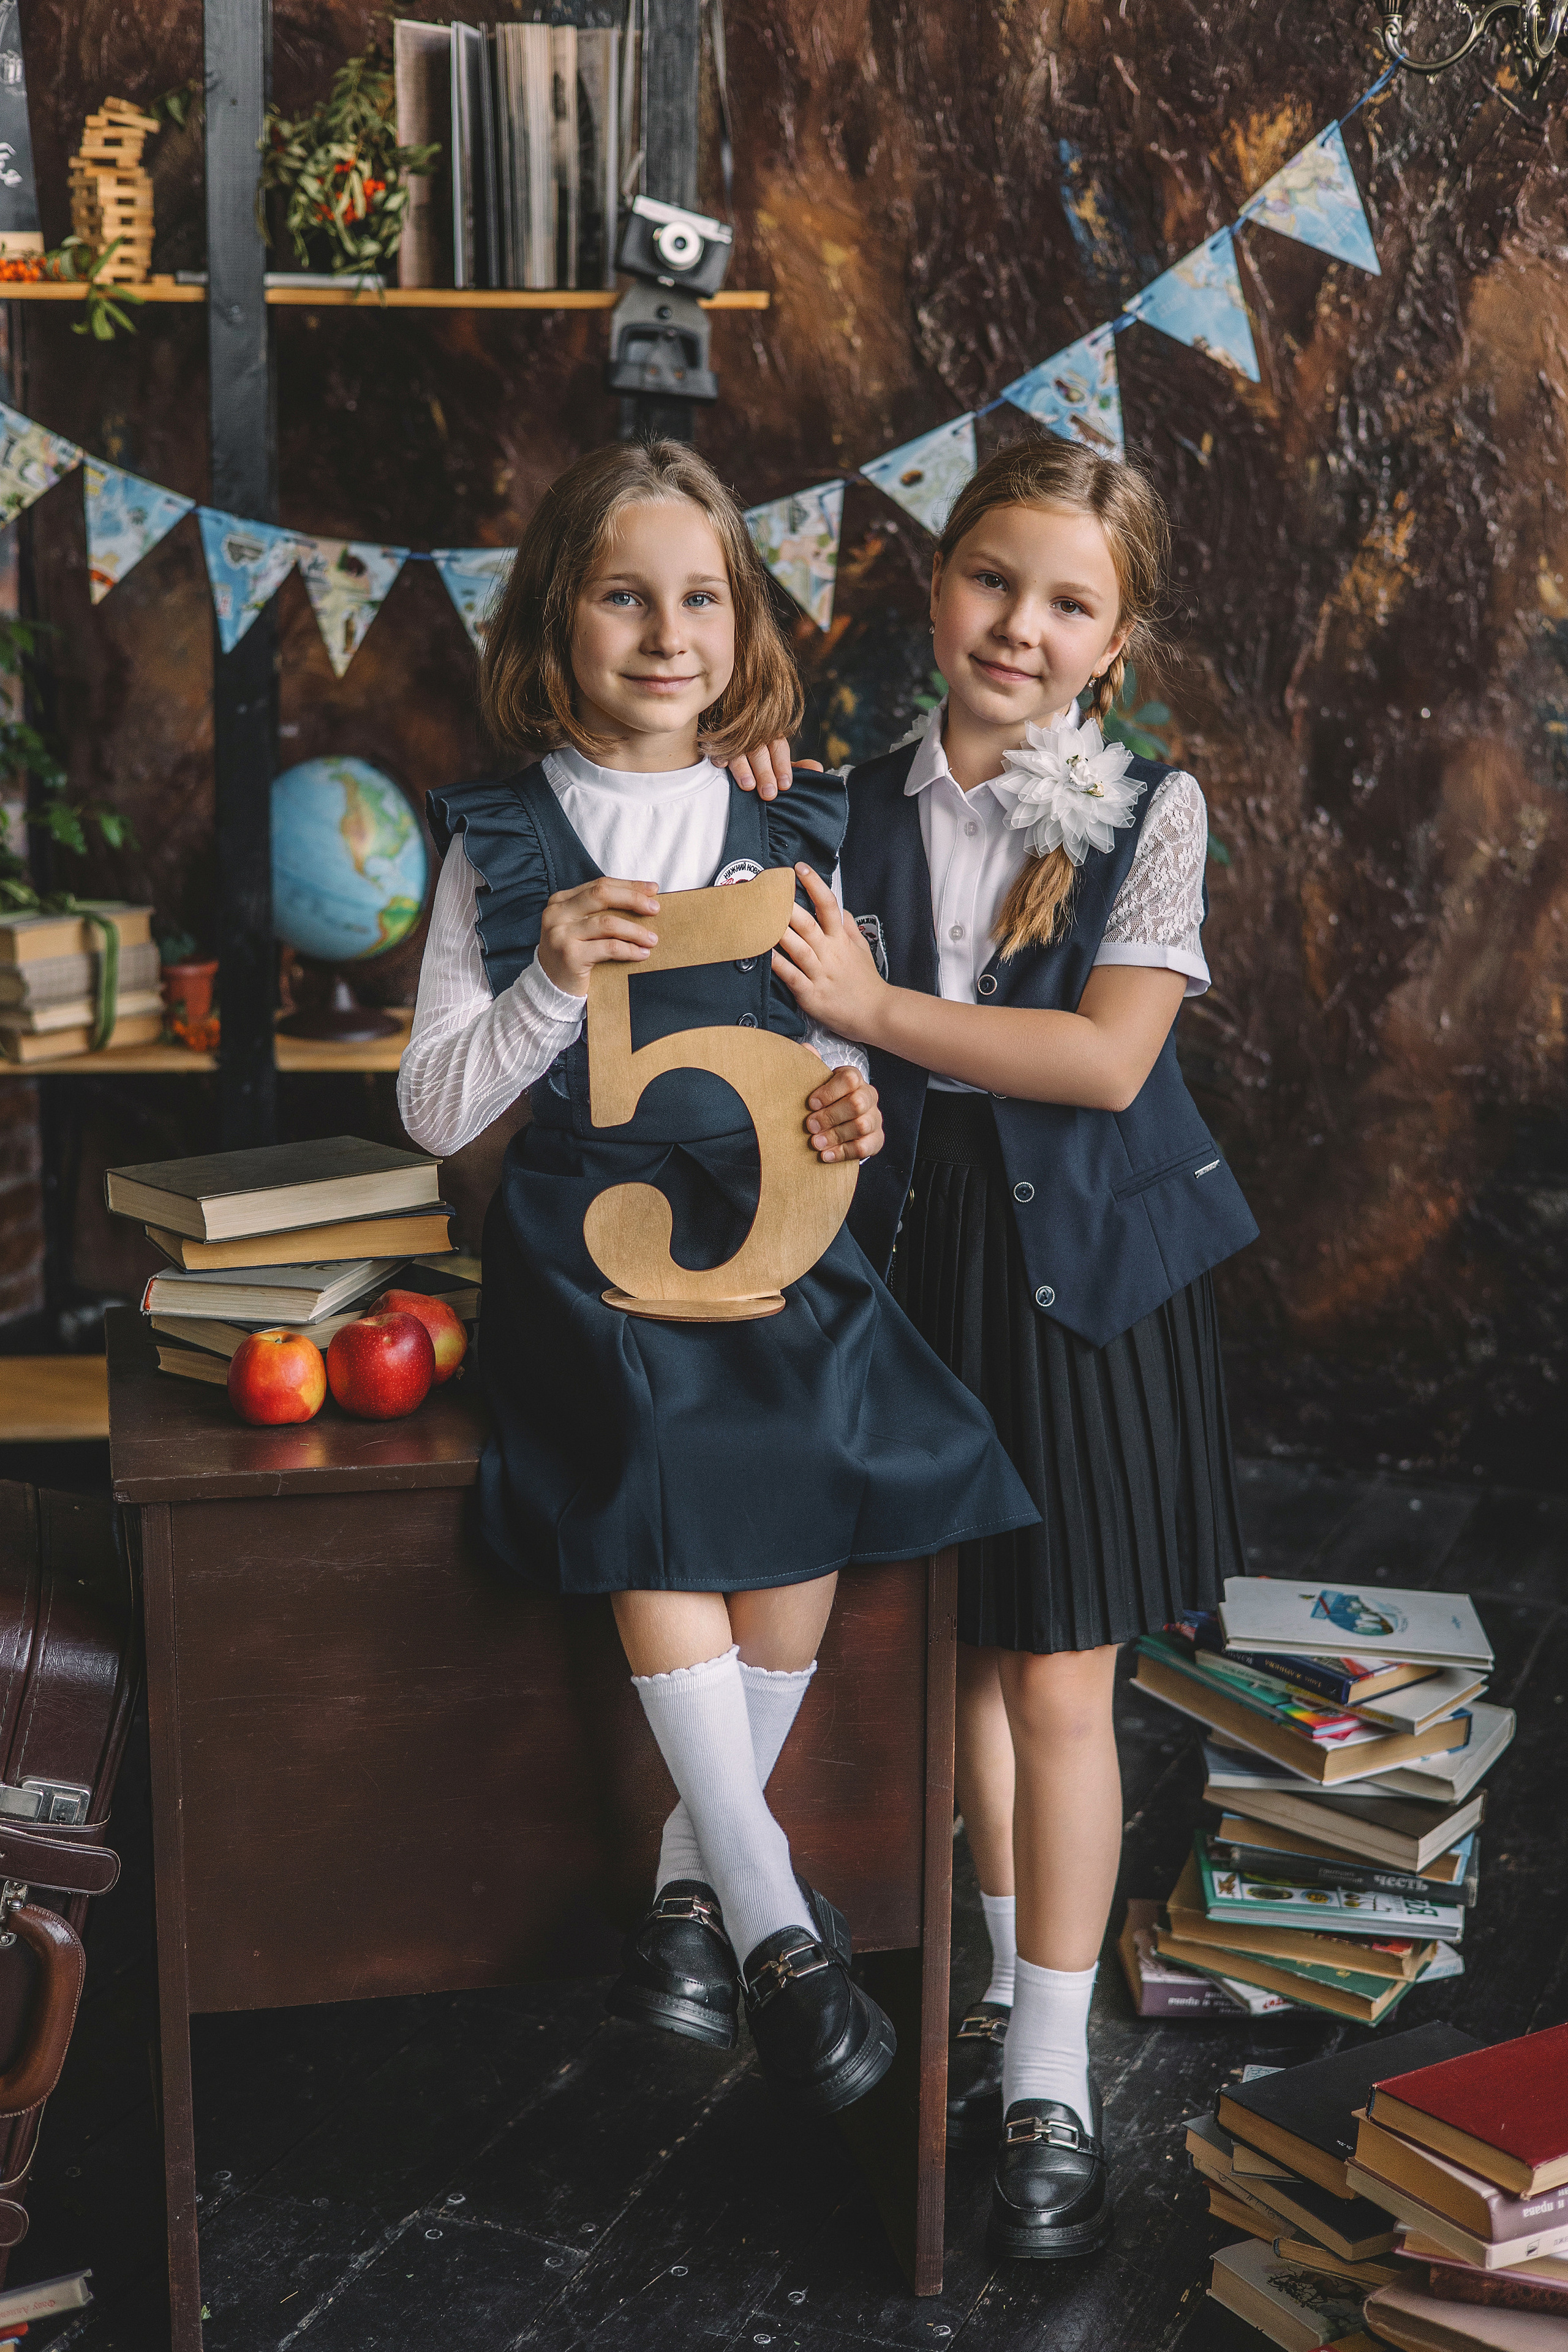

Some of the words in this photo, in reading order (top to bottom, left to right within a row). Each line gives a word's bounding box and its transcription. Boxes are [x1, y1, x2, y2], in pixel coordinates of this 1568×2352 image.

[723, 862, 746, 879] НИЖНИЙ
[583, 867, 860, 1299] 5
[1523, 2200, 1555, 2218] права
